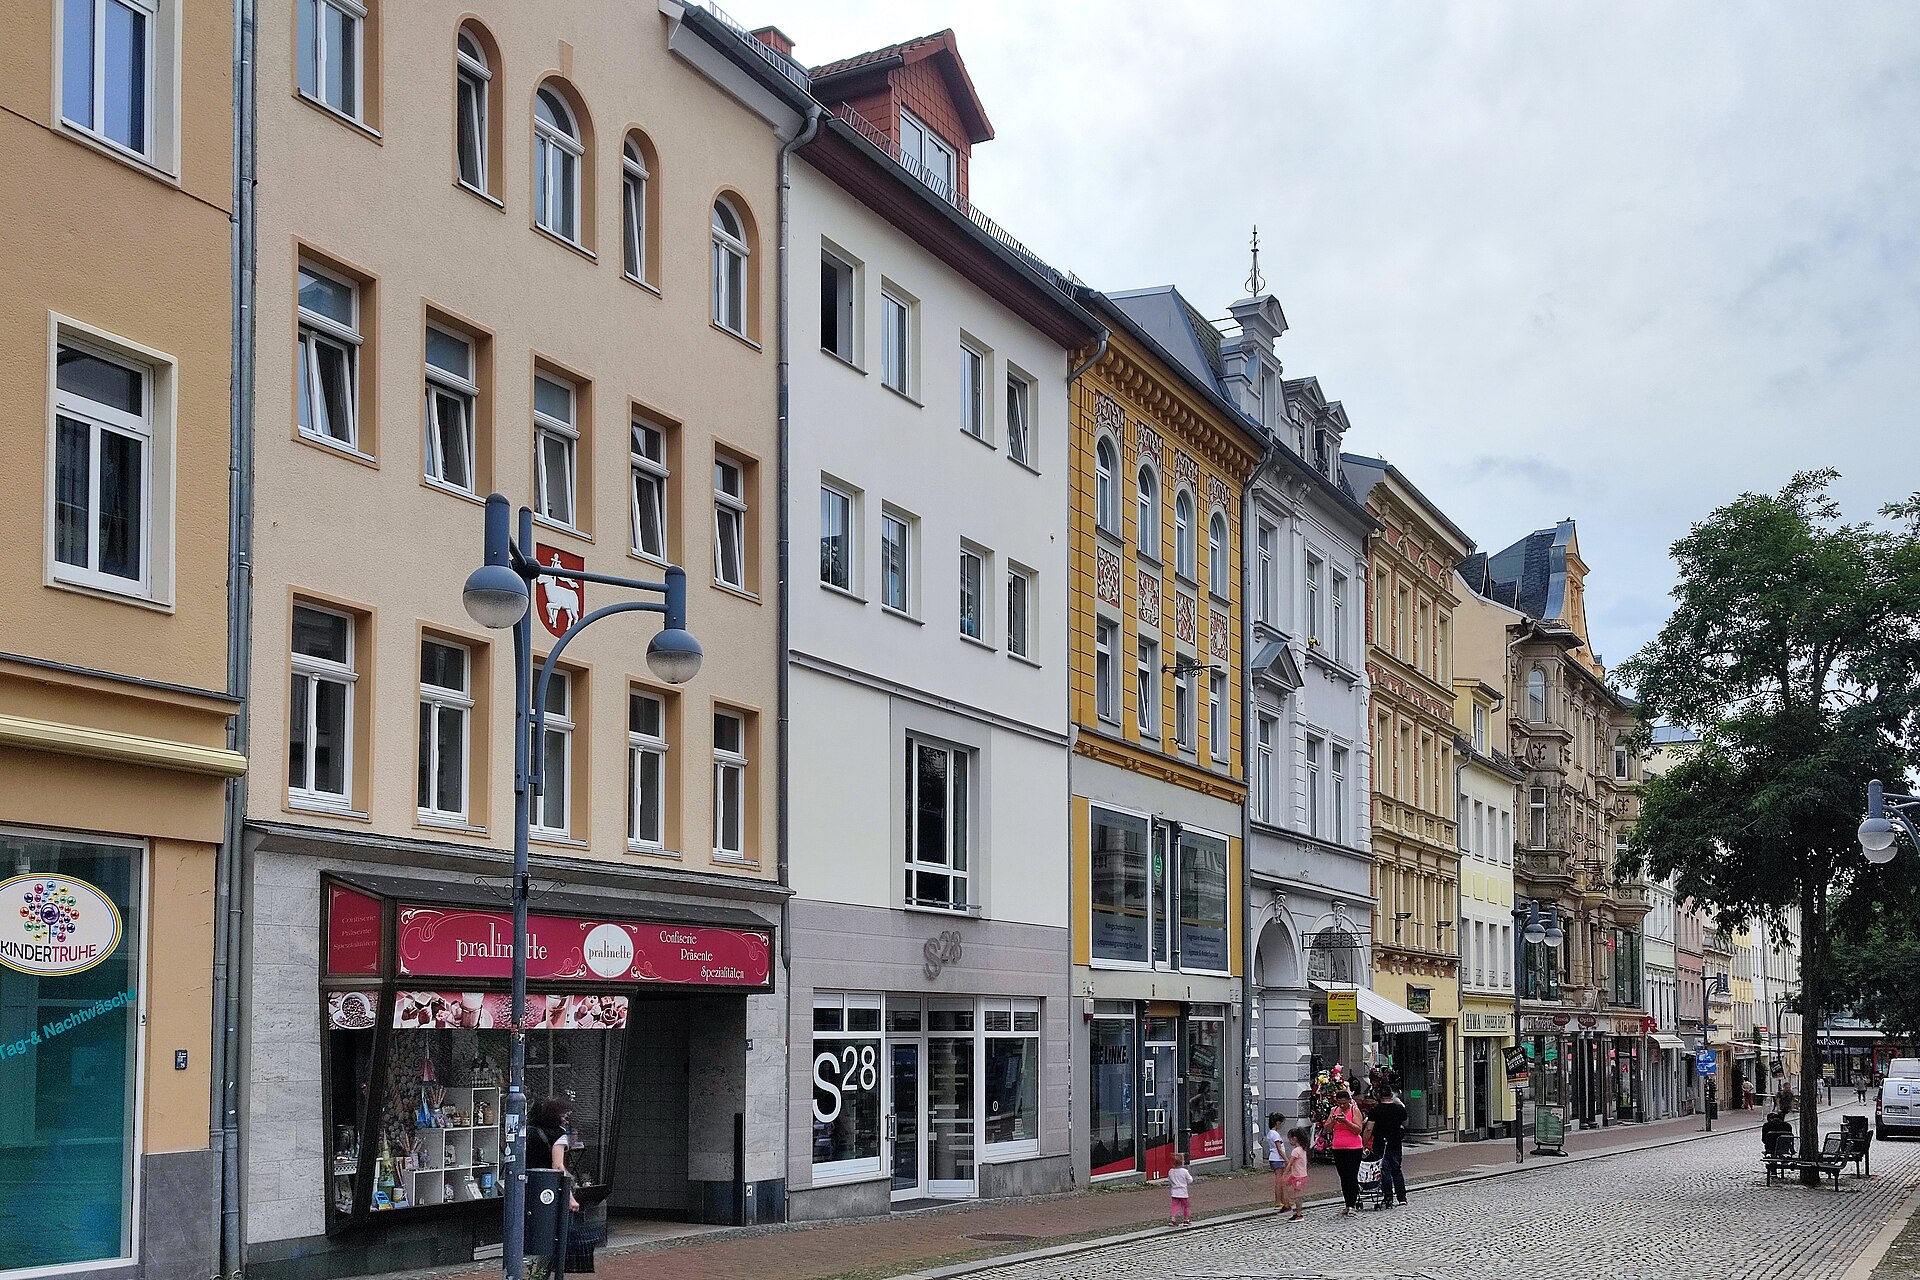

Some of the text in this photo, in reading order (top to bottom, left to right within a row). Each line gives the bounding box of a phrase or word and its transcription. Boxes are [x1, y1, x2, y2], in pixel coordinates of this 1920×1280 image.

[455, 922, 548, 963] pralintte
[659, 930, 697, 945] Confiserie
[0, 941, 97, 963] KINDERTRUHE
[587, 940, 632, 960] pralinette
[680, 948, 713, 962] Präsente
[923, 930, 963, 981] S28
[700, 965, 745, 982] Spezialitäten
[812, 1045, 877, 1123] S28
